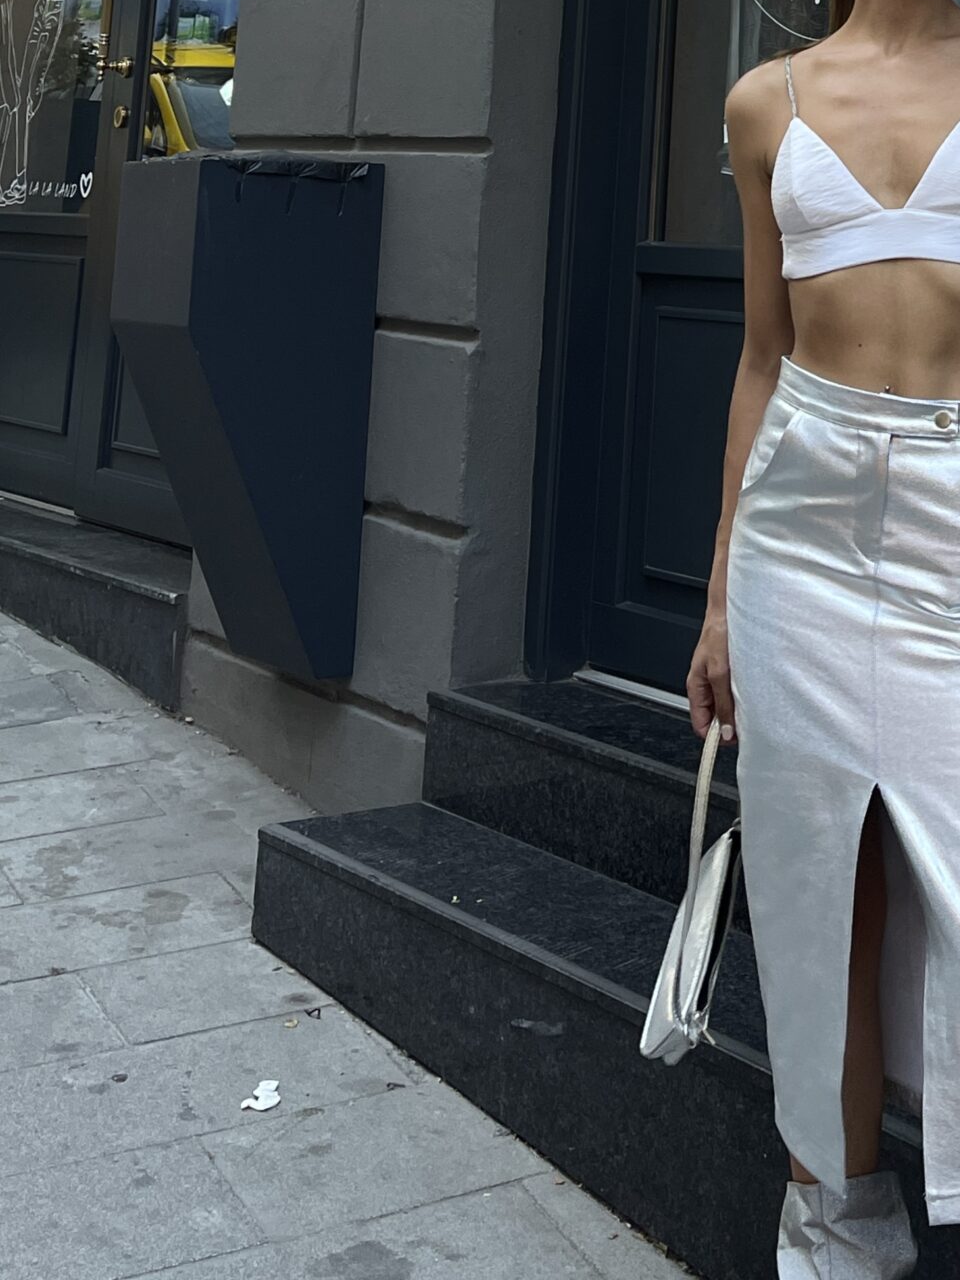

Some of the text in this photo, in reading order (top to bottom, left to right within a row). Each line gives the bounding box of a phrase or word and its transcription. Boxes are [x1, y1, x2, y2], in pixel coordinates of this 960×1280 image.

[28, 181, 78, 198] LA LA LAND
